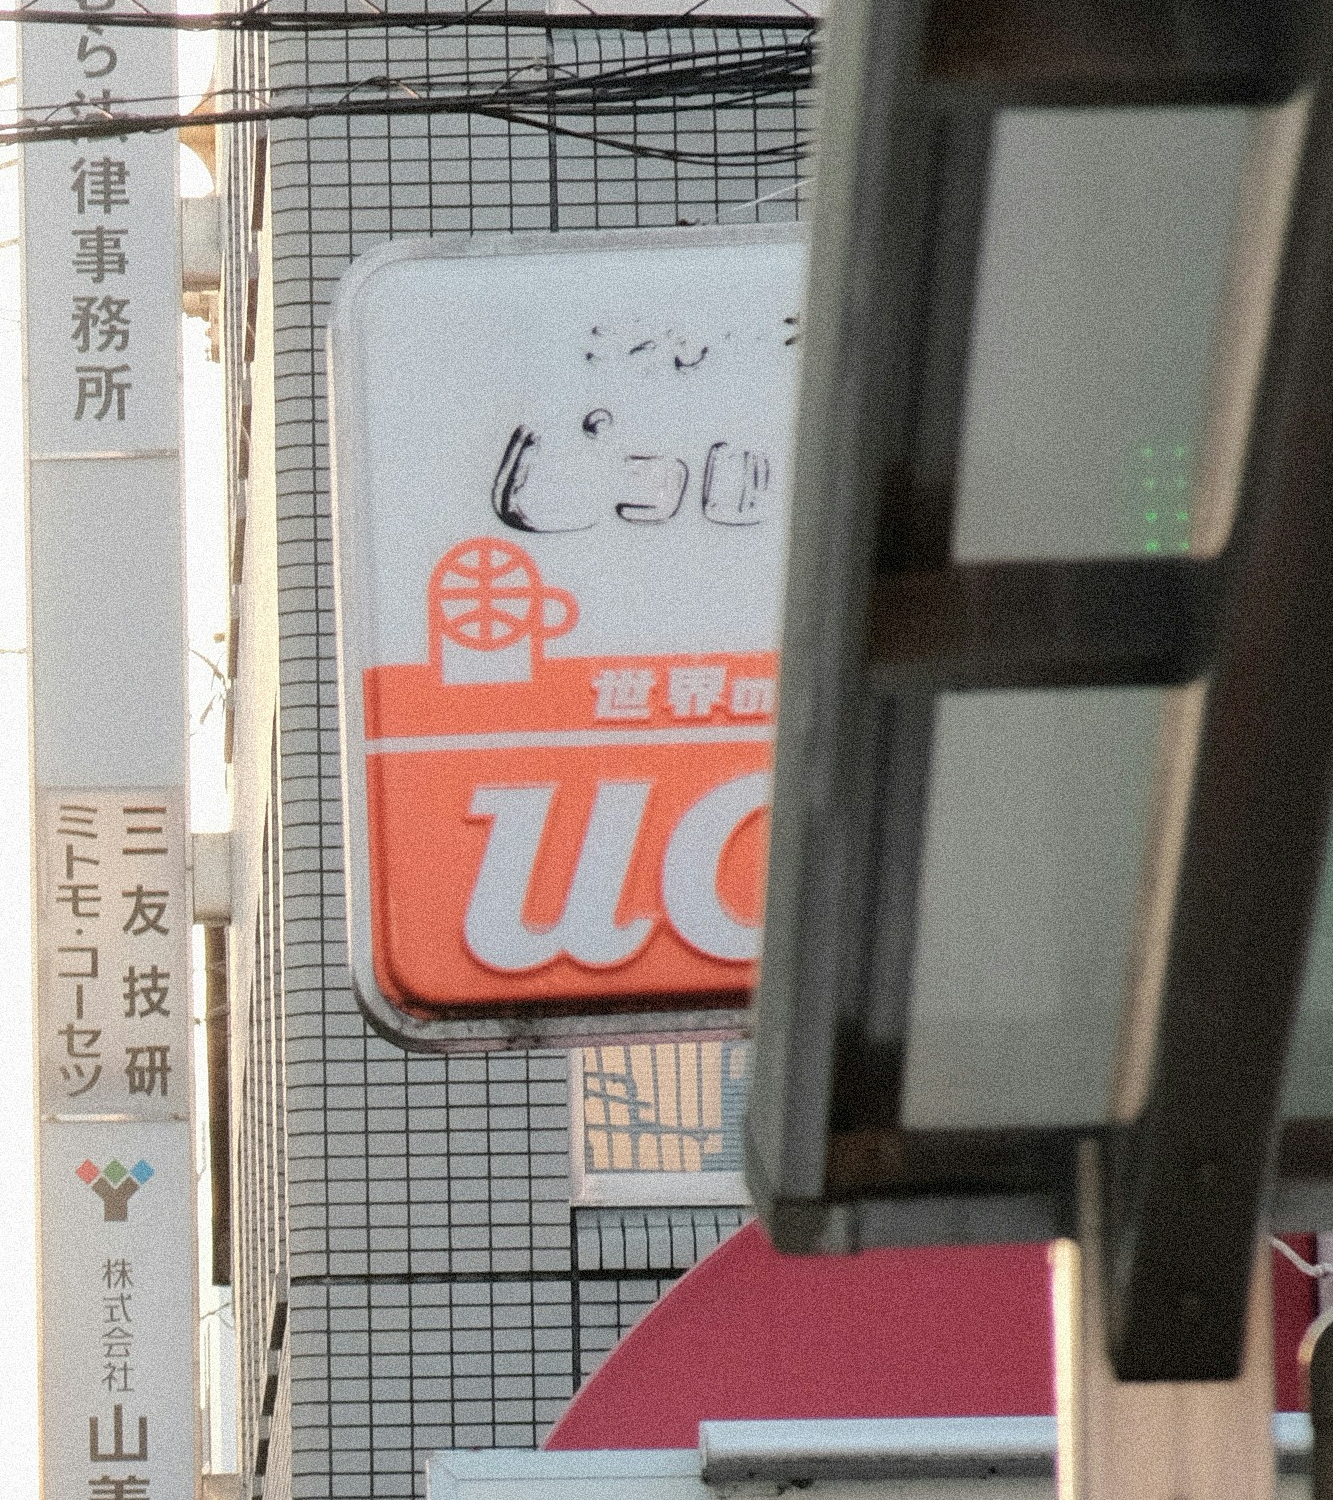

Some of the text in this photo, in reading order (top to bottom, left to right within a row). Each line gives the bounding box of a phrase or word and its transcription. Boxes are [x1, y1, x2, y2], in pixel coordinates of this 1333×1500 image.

[56, 804, 102, 1097] ミトモ・コーセツ
[121, 806, 172, 1098] 三友技研
[102, 1258, 135, 1393] 株式会社
